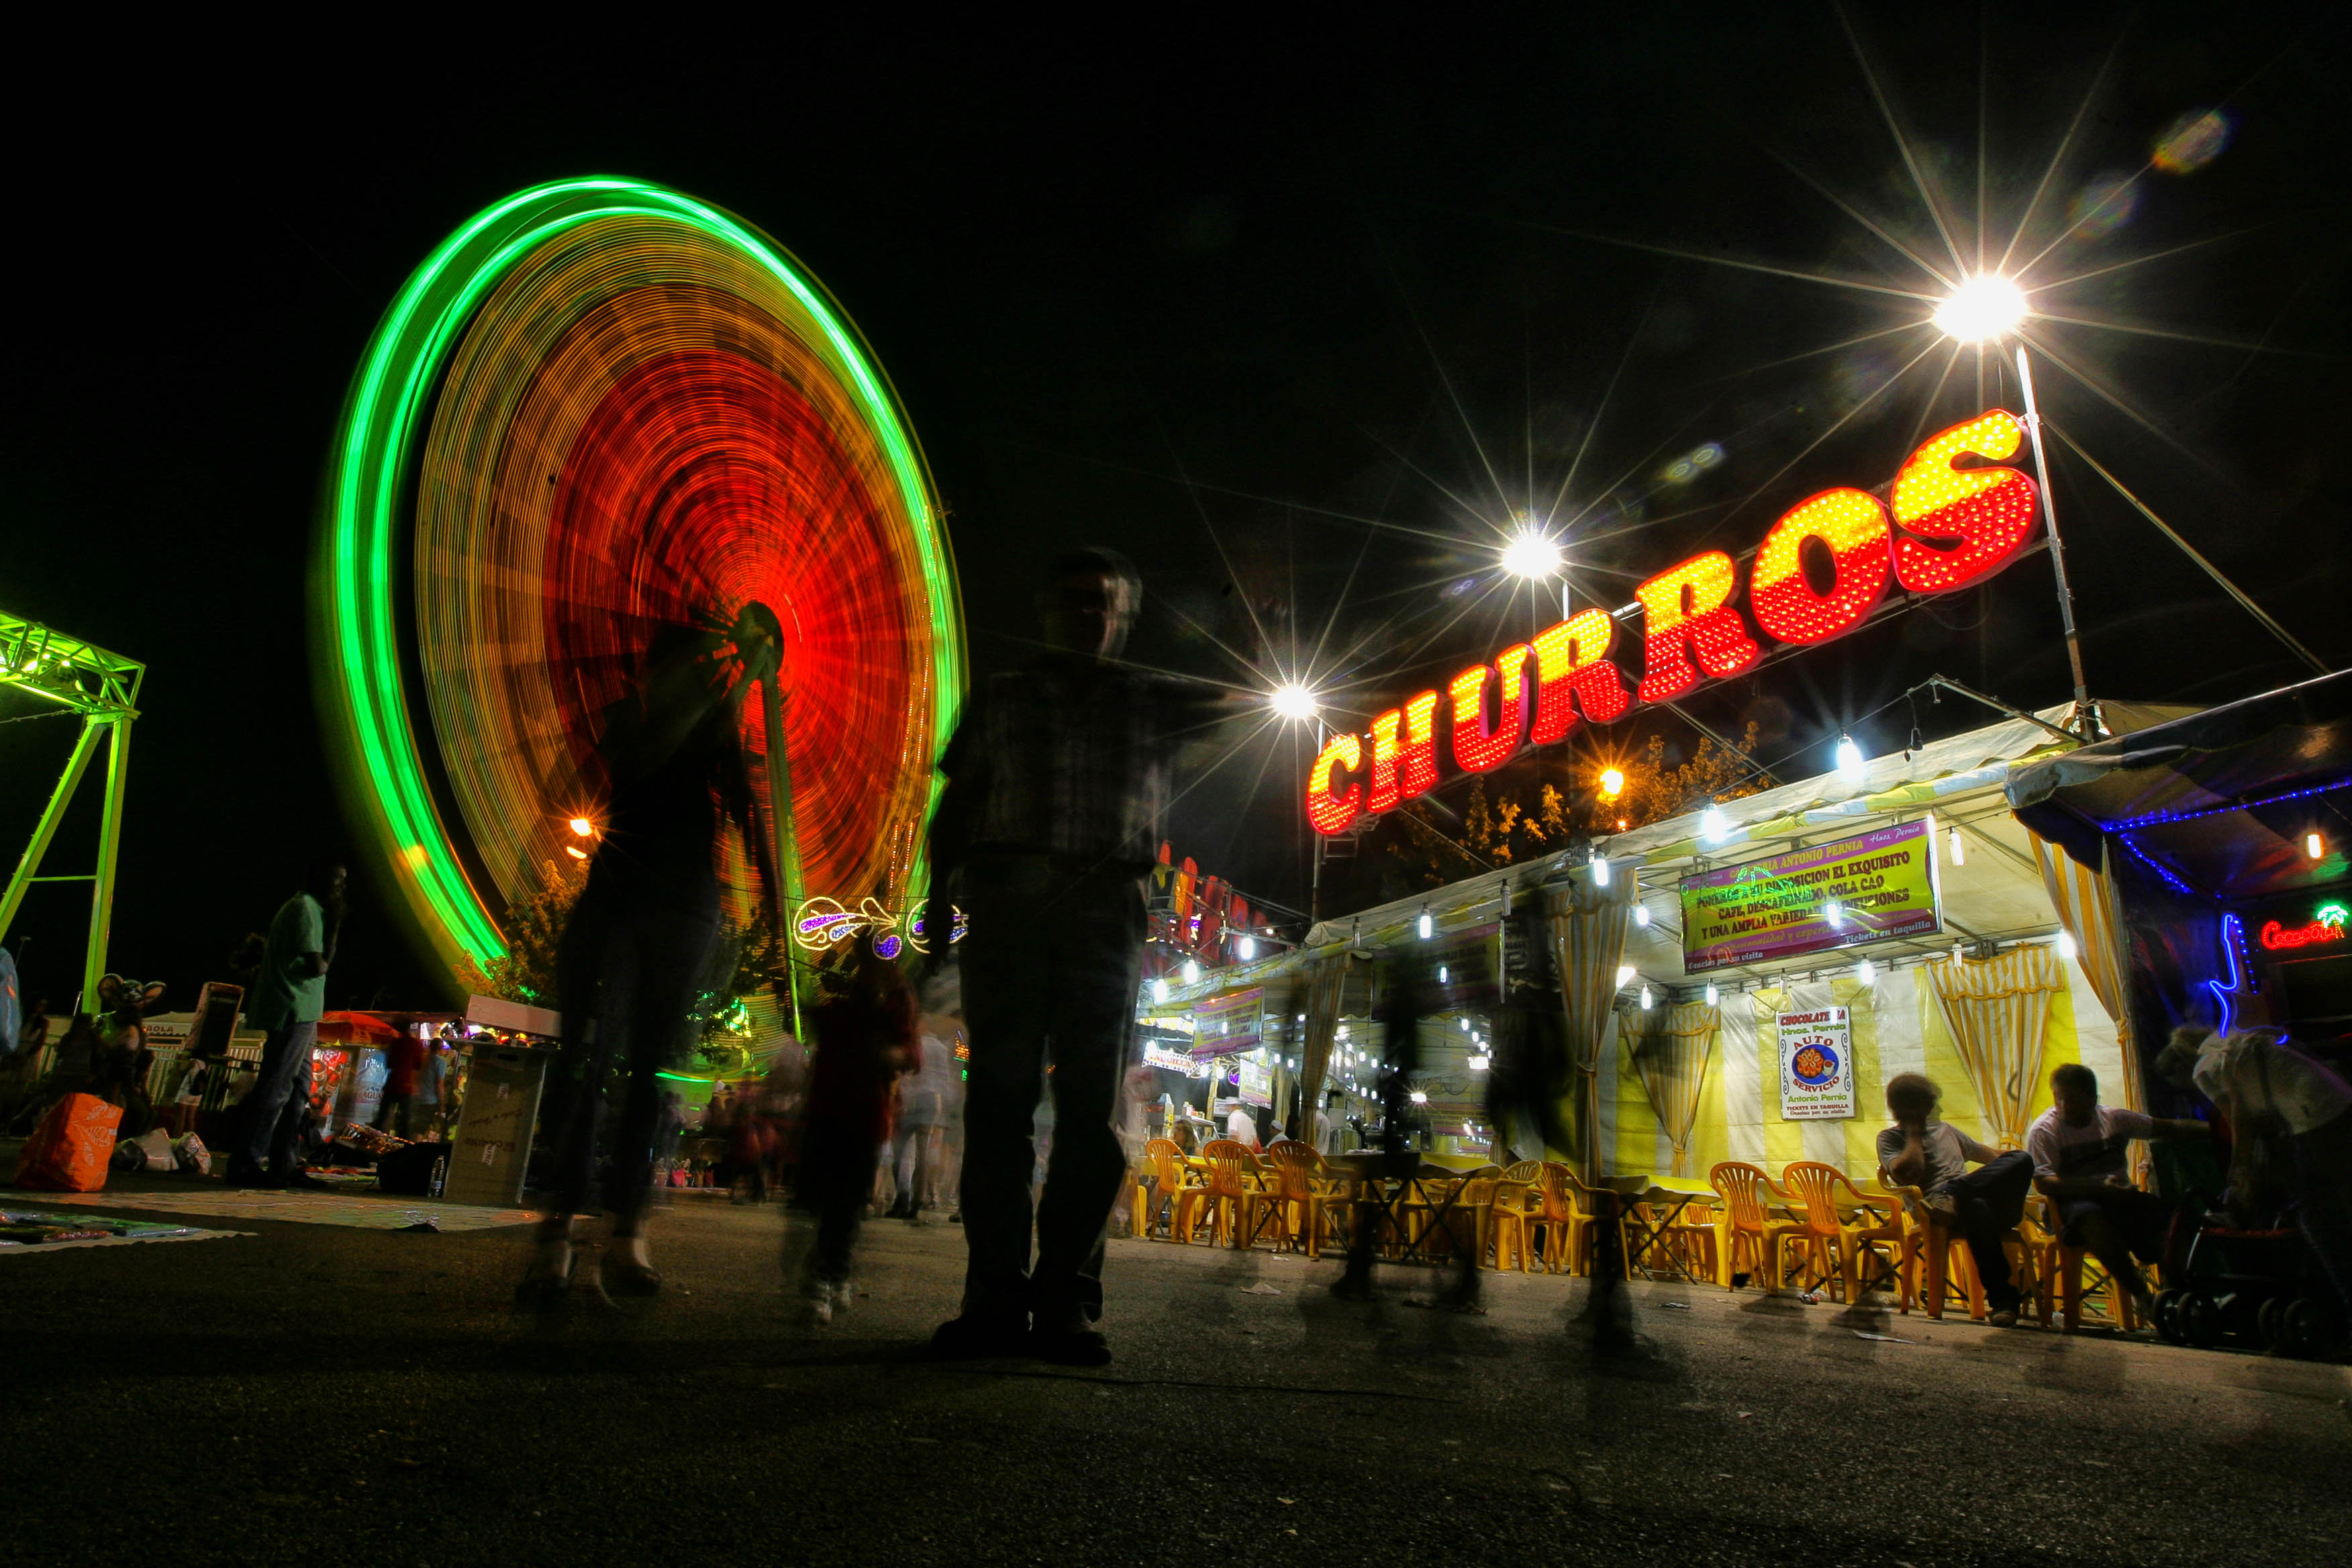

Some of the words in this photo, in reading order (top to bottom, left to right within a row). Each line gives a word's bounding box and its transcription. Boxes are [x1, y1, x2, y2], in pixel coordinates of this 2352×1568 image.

[1308, 409, 2041, 836] CHURROS
[1781, 848, 1824, 869] ANTONIO
[1825, 840, 1864, 858] PERNIA
[1832, 865, 1846, 879] EL
[1847, 850, 1910, 876] EXQUISITO
[1828, 880, 1858, 897] COLA
[1860, 875, 1885, 891] CAO
[1701, 927, 1709, 940] Y
[1710, 924, 1730, 938] UNA
[1731, 916, 1768, 934] AMPLIA
[1845, 932, 1877, 944] Tickets
[1893, 920, 1931, 934] taquilla
[1741, 951, 1763, 961] visita
[1780, 1009, 1846, 1026] CHOCOLATEIA
[1793, 1035, 1834, 1050] AUTO
[1792, 1075, 1840, 1093] SERVICIO
[1787, 1095, 1819, 1103] Antonio
